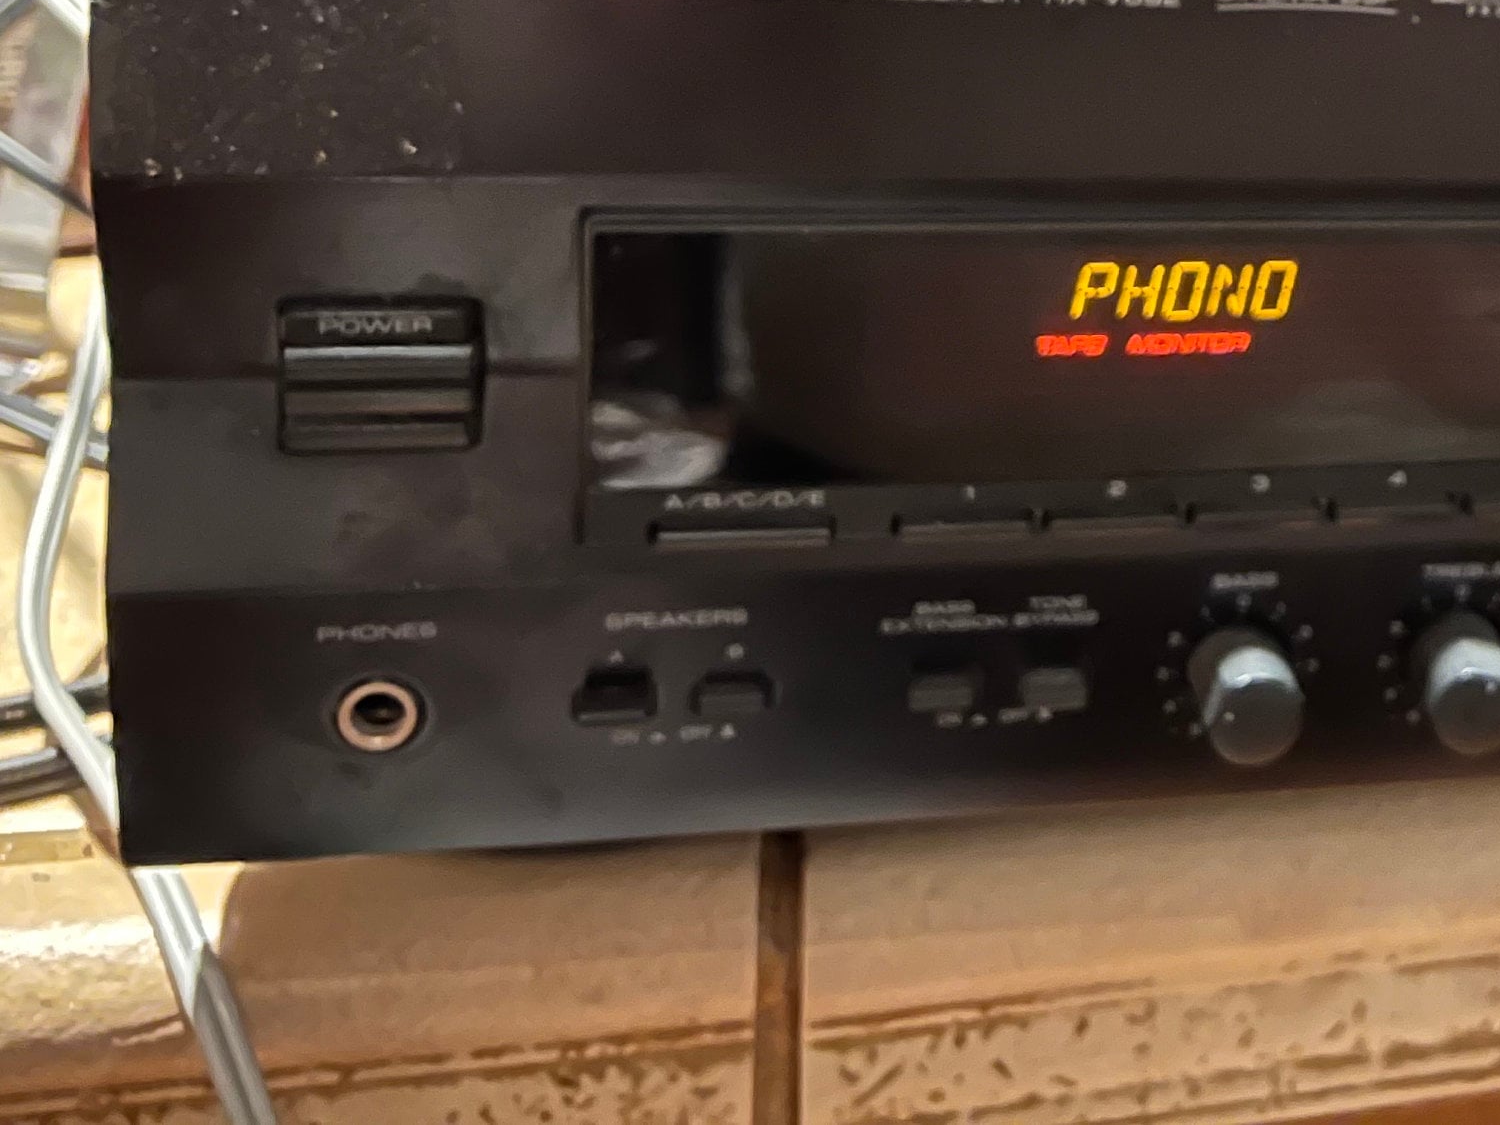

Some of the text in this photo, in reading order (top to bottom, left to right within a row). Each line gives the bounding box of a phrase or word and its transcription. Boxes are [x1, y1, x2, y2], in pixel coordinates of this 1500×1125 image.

[1068, 261, 1299, 321] PHONO
[316, 312, 434, 336] POWER
[605, 608, 747, 631] SPEAKERS
[316, 621, 438, 642] PHONES
